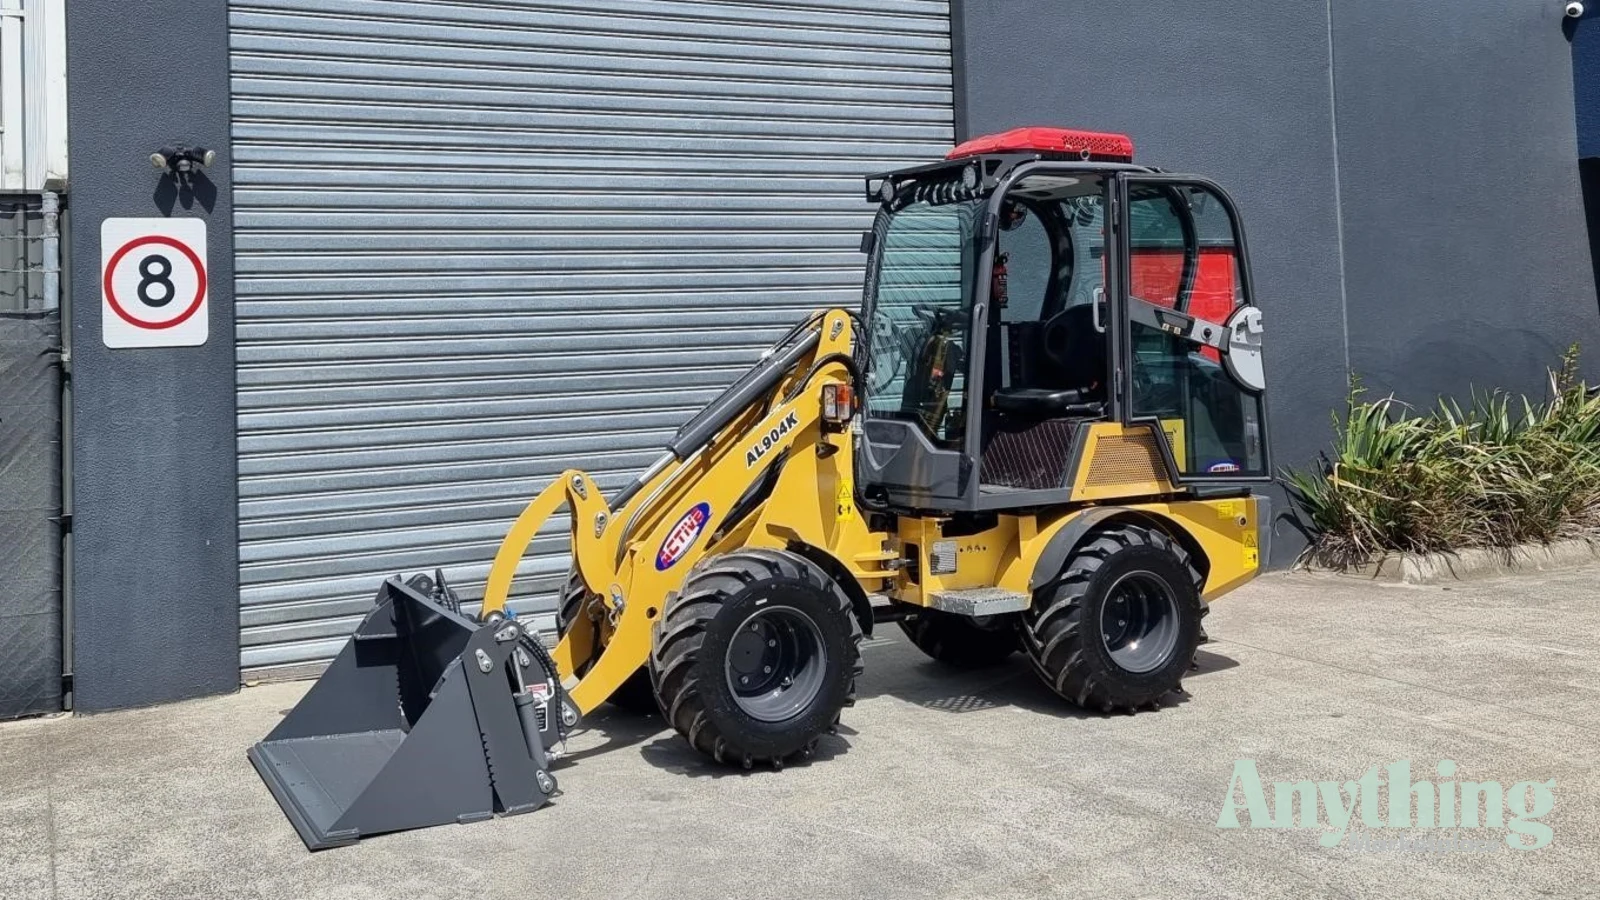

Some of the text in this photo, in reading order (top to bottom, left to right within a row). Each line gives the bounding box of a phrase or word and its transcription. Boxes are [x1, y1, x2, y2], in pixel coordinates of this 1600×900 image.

[137, 254, 175, 308] 8
[746, 412, 798, 467] AL904K
[660, 508, 705, 567] ACTIVE
